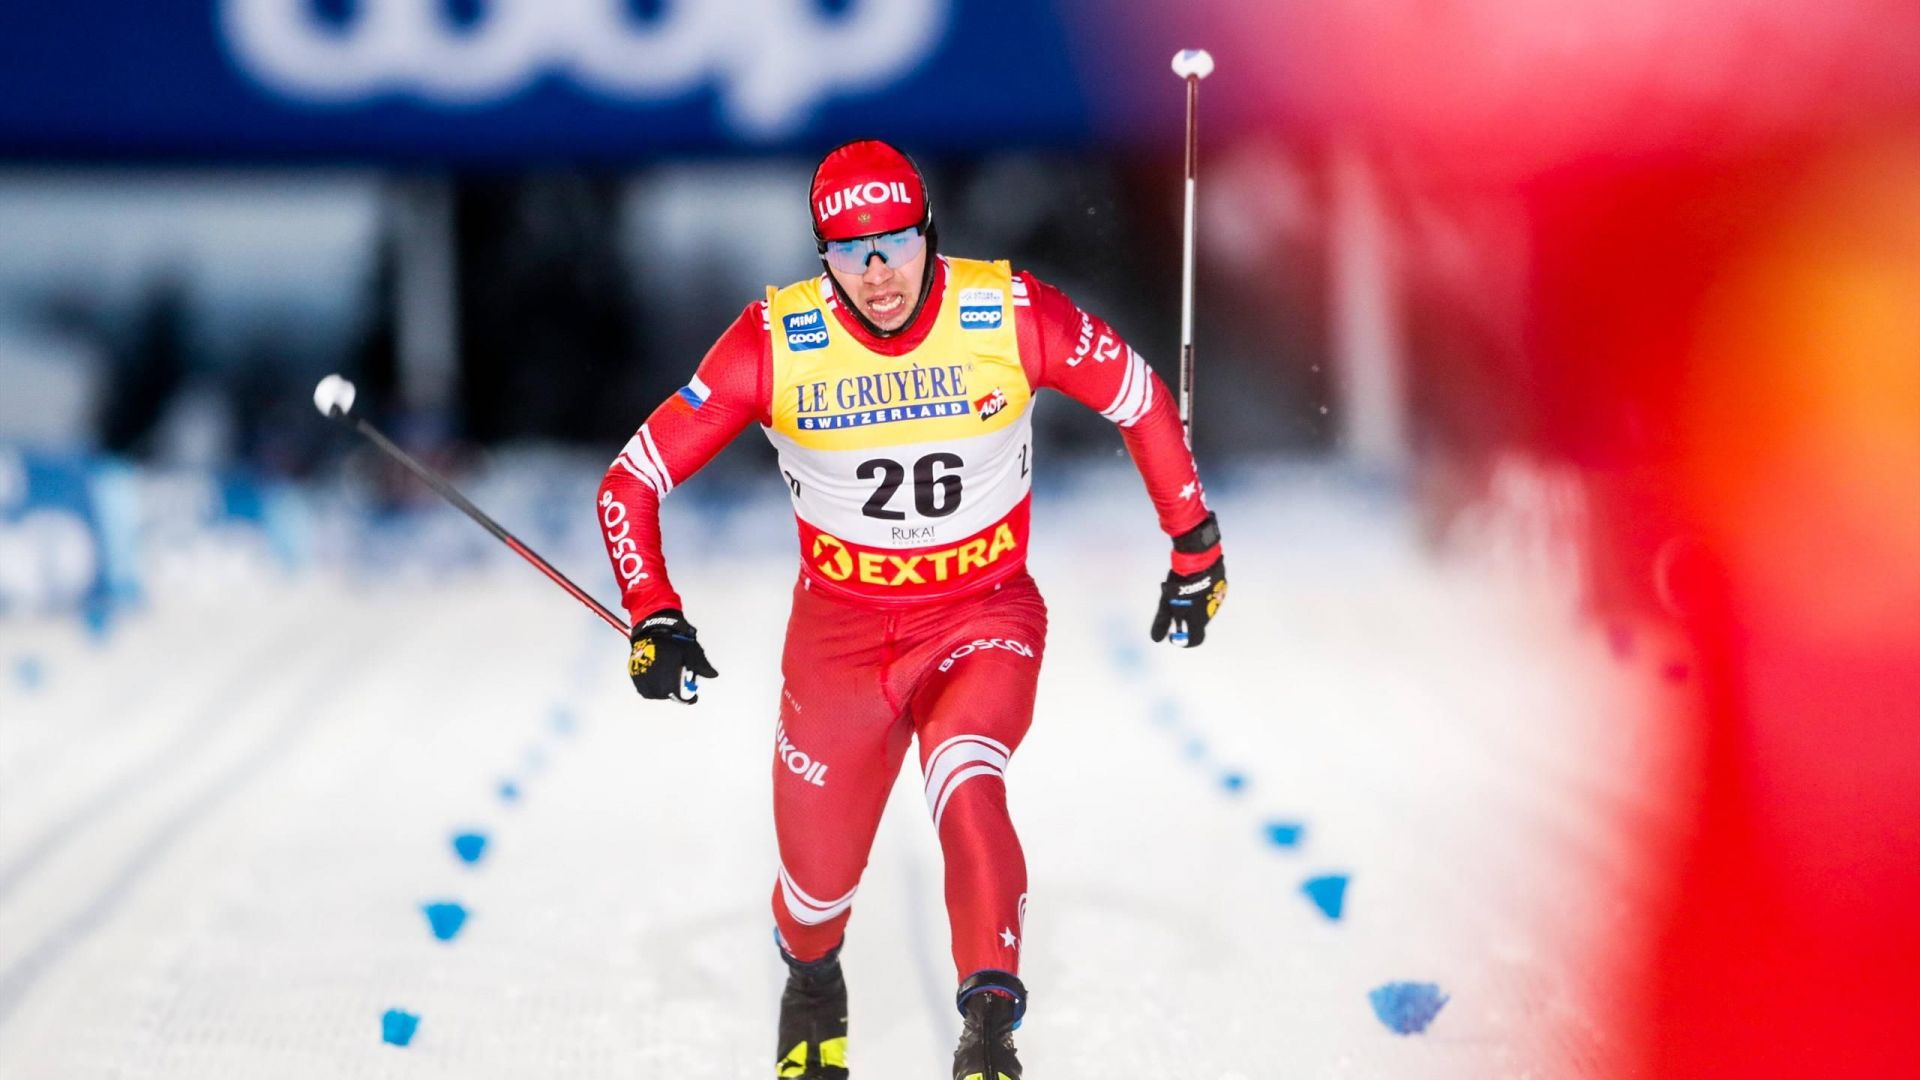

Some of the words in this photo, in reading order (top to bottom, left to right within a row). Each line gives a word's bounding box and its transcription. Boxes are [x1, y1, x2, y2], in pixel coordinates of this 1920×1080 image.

[818, 181, 912, 222] LUKOIL
[788, 331, 827, 344] coop
[960, 311, 1001, 324] coop
[1065, 306, 1094, 367] LUKO
[796, 382, 829, 414] LE
[836, 362, 968, 410] GRUYÈRE
[804, 402, 963, 430] SWITZERLAND
[856, 452, 965, 521] 26
[857, 521, 1017, 587] EXTRA
[938, 638, 1027, 673] BOSCO
[776, 719, 829, 787] UKOIL
